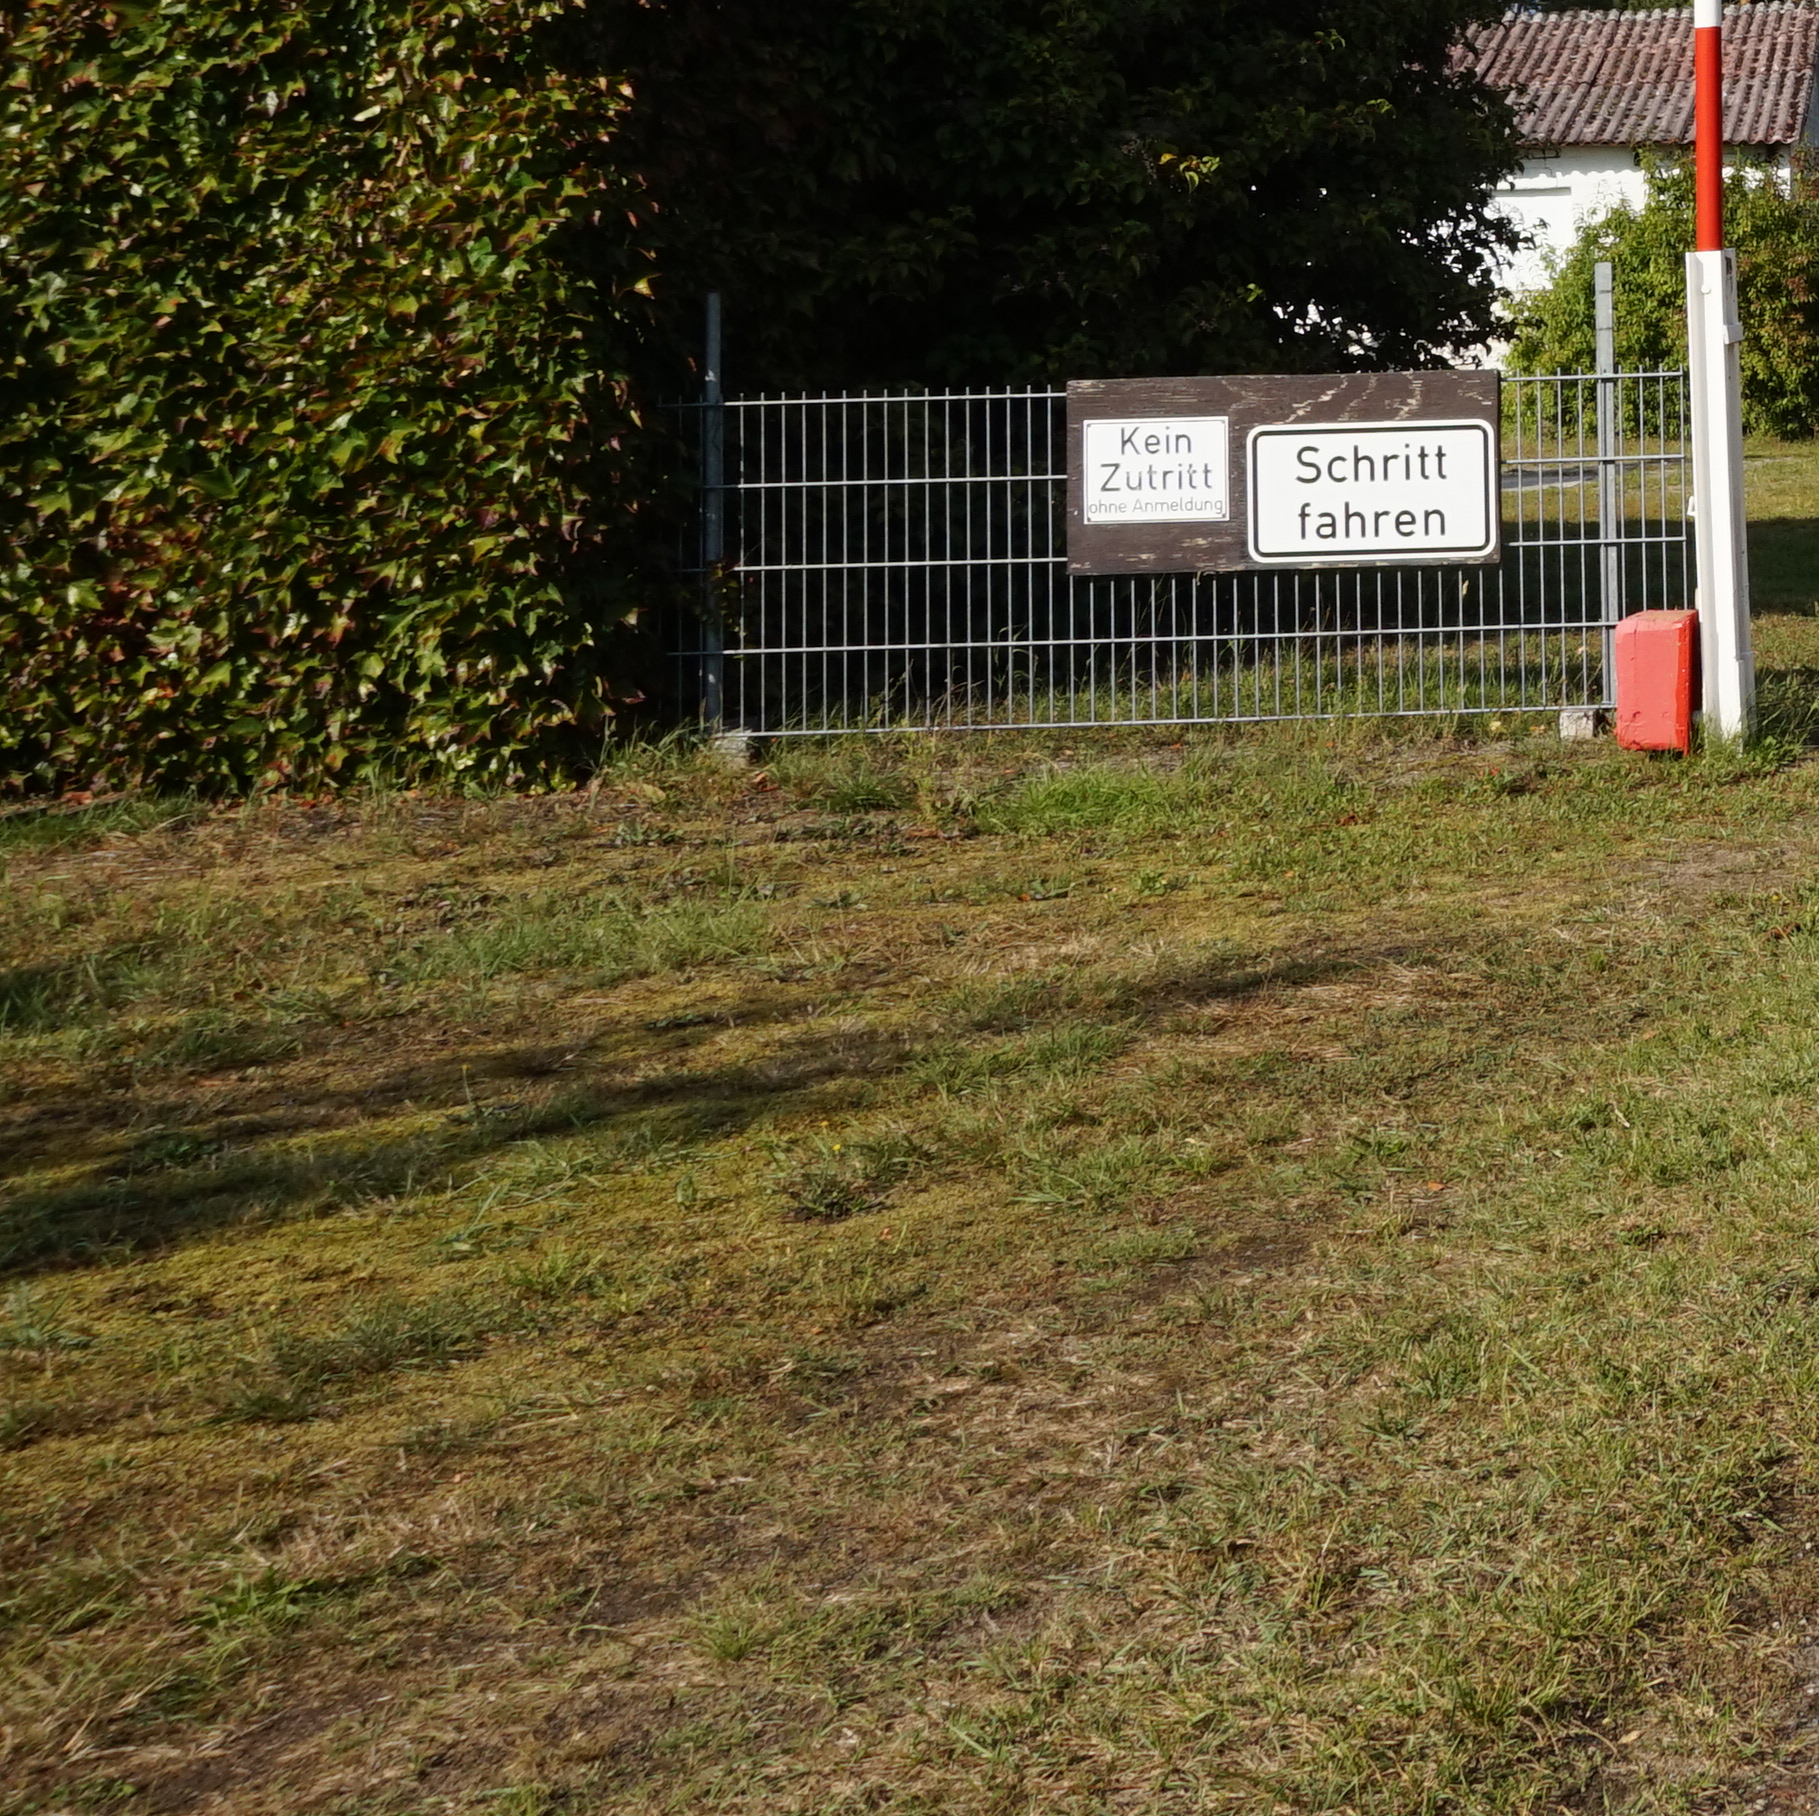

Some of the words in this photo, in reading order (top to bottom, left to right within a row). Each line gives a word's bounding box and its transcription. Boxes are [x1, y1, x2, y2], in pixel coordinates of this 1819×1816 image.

[1121, 426, 1192, 455] Kein
[1100, 463, 1213, 492] Zutritt
[1295, 443, 1447, 484] Schritt
[1089, 499, 1127, 515] ohne
[1132, 496, 1223, 515] Anmeldung
[1298, 501, 1446, 540] fahren
